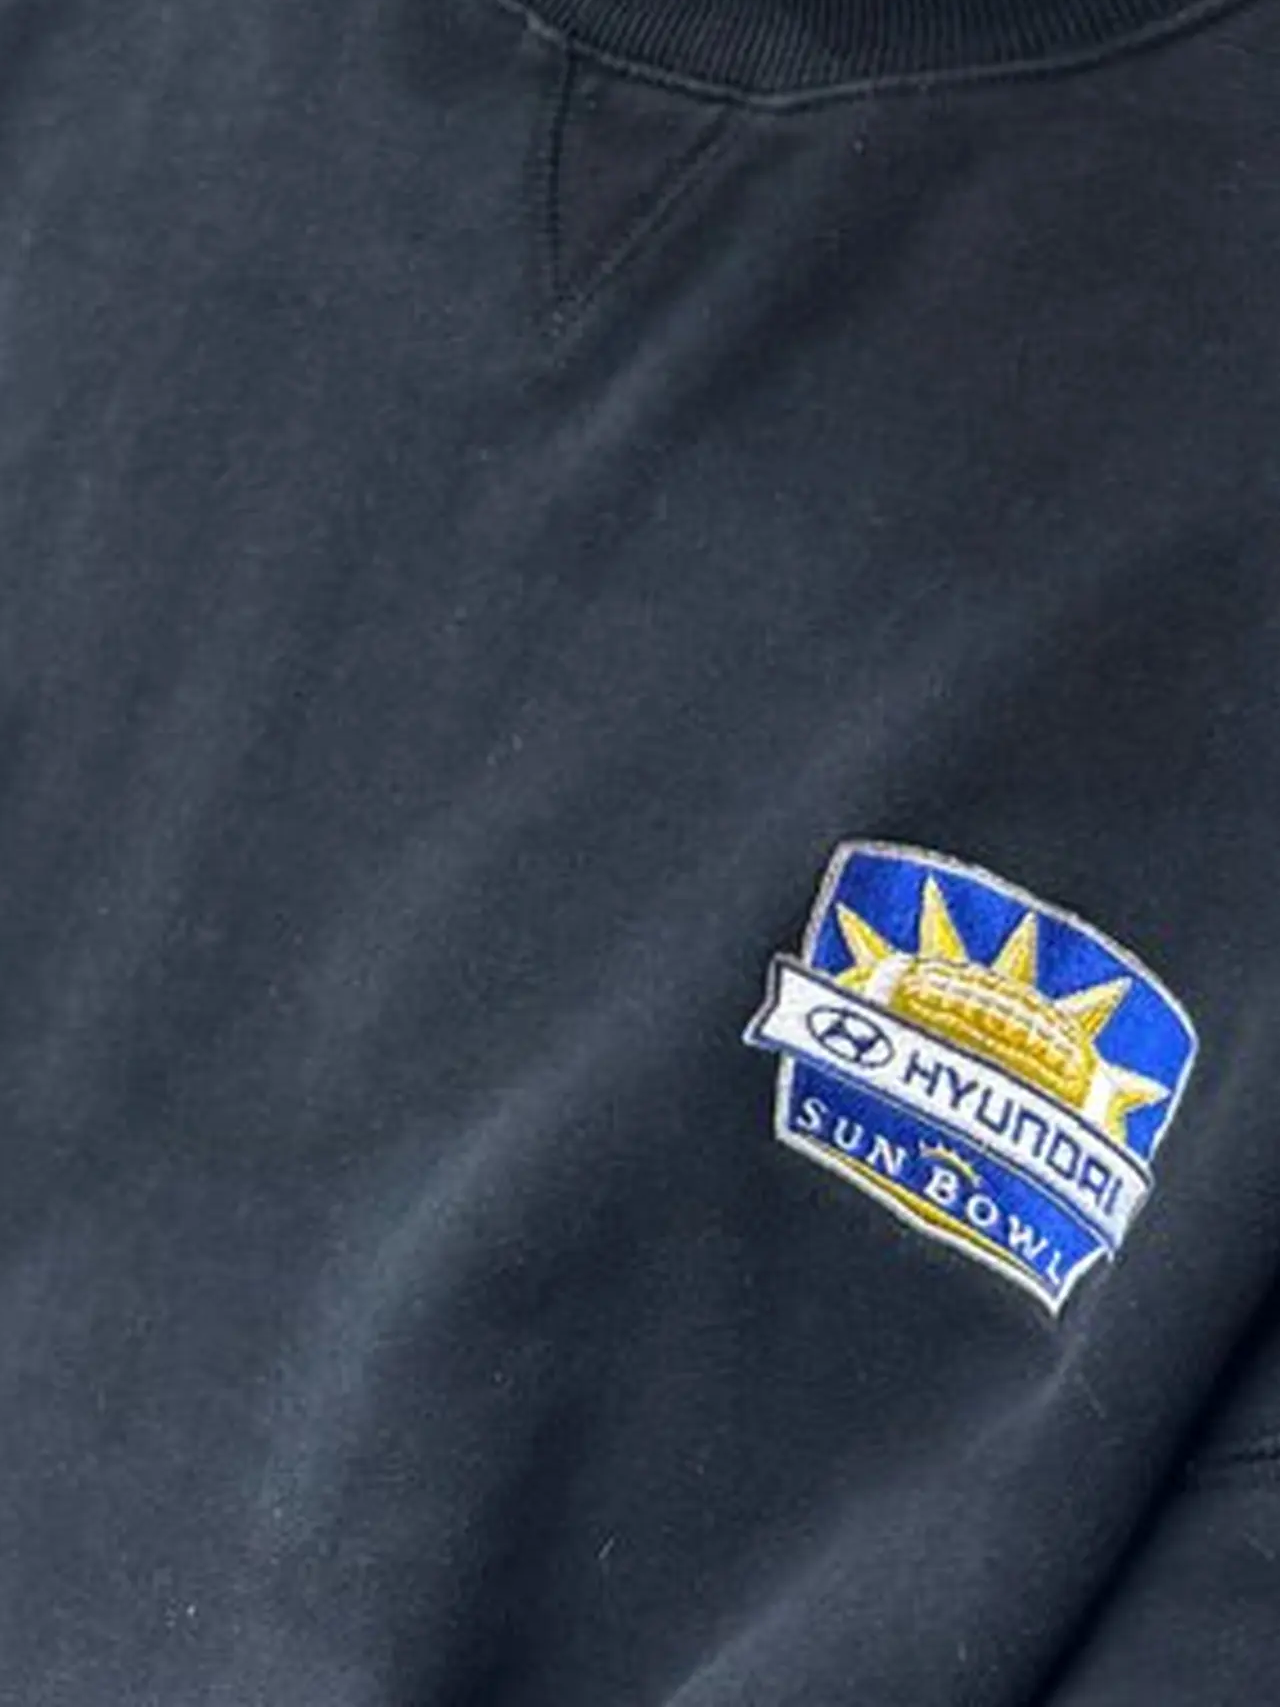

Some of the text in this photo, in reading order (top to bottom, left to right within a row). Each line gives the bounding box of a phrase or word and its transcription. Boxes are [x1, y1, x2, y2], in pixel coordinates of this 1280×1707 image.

[796, 1097, 1064, 1287] SUN BOWL
[902, 1048, 1122, 1216] HYUNDAI
